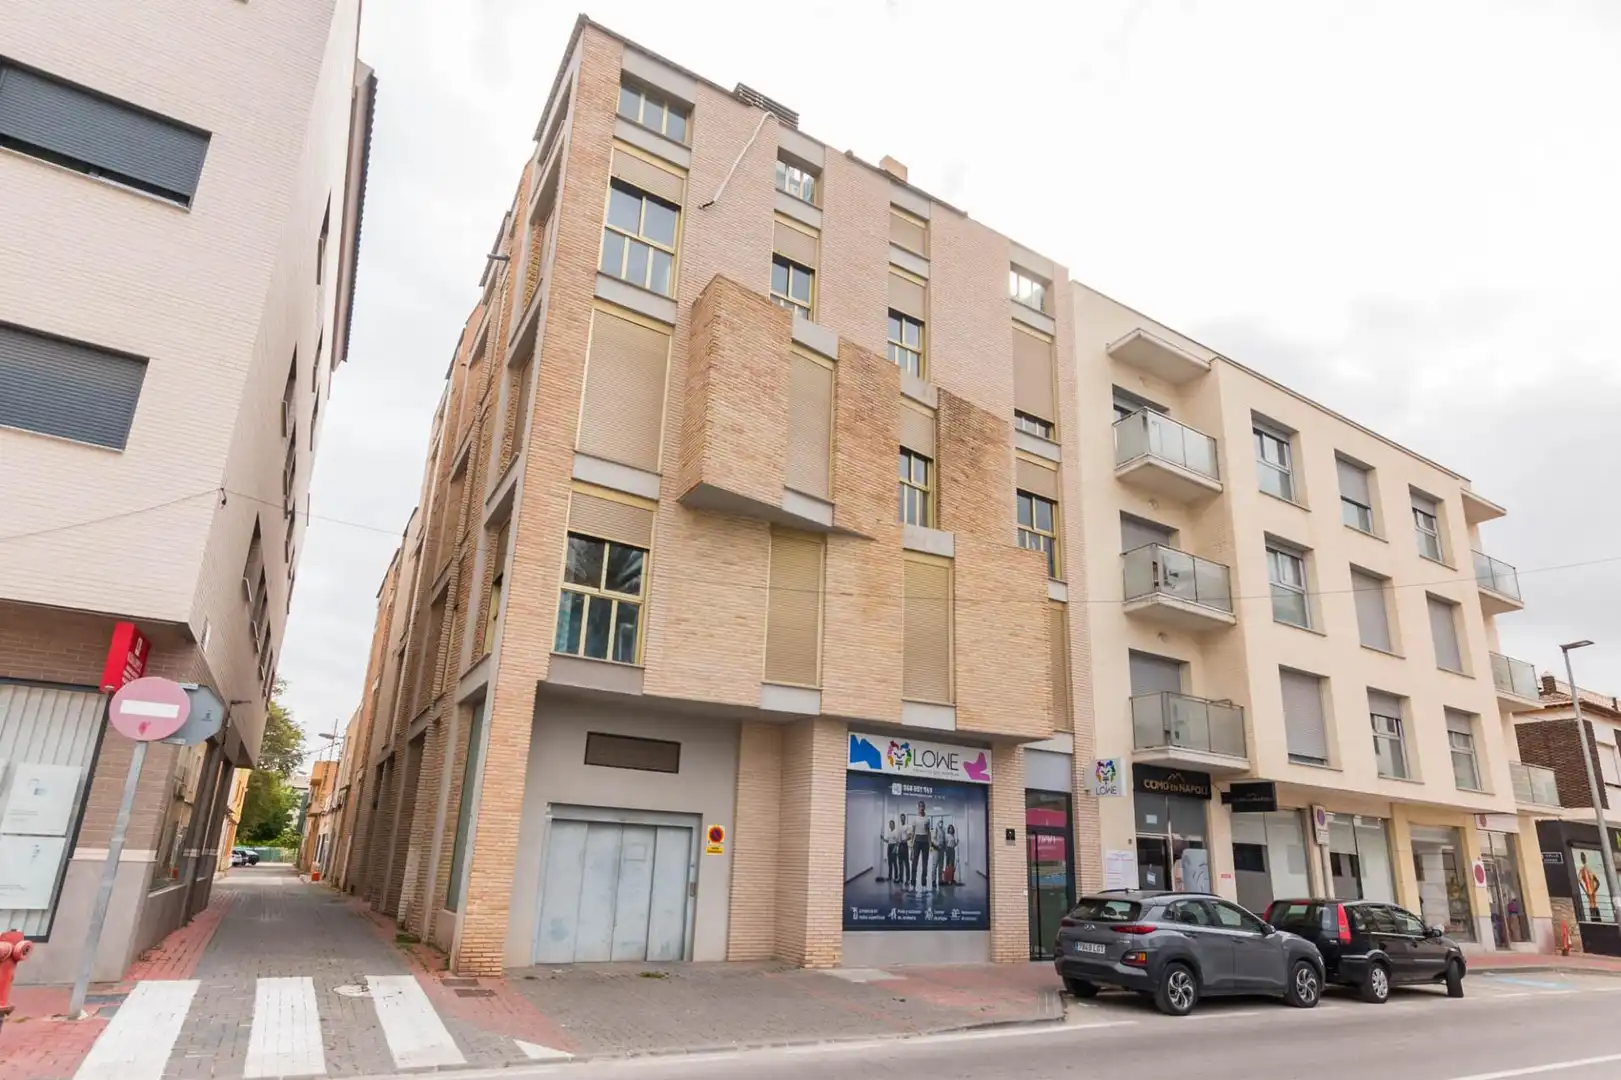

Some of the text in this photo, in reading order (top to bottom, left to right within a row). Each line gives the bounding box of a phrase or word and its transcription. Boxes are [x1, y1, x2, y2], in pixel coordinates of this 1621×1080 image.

[913, 748, 959, 771] LOWE
[1096, 785, 1117, 796] LOWE
[1143, 779, 1169, 791] COMO
[1179, 783, 1208, 796] NAPOLI
